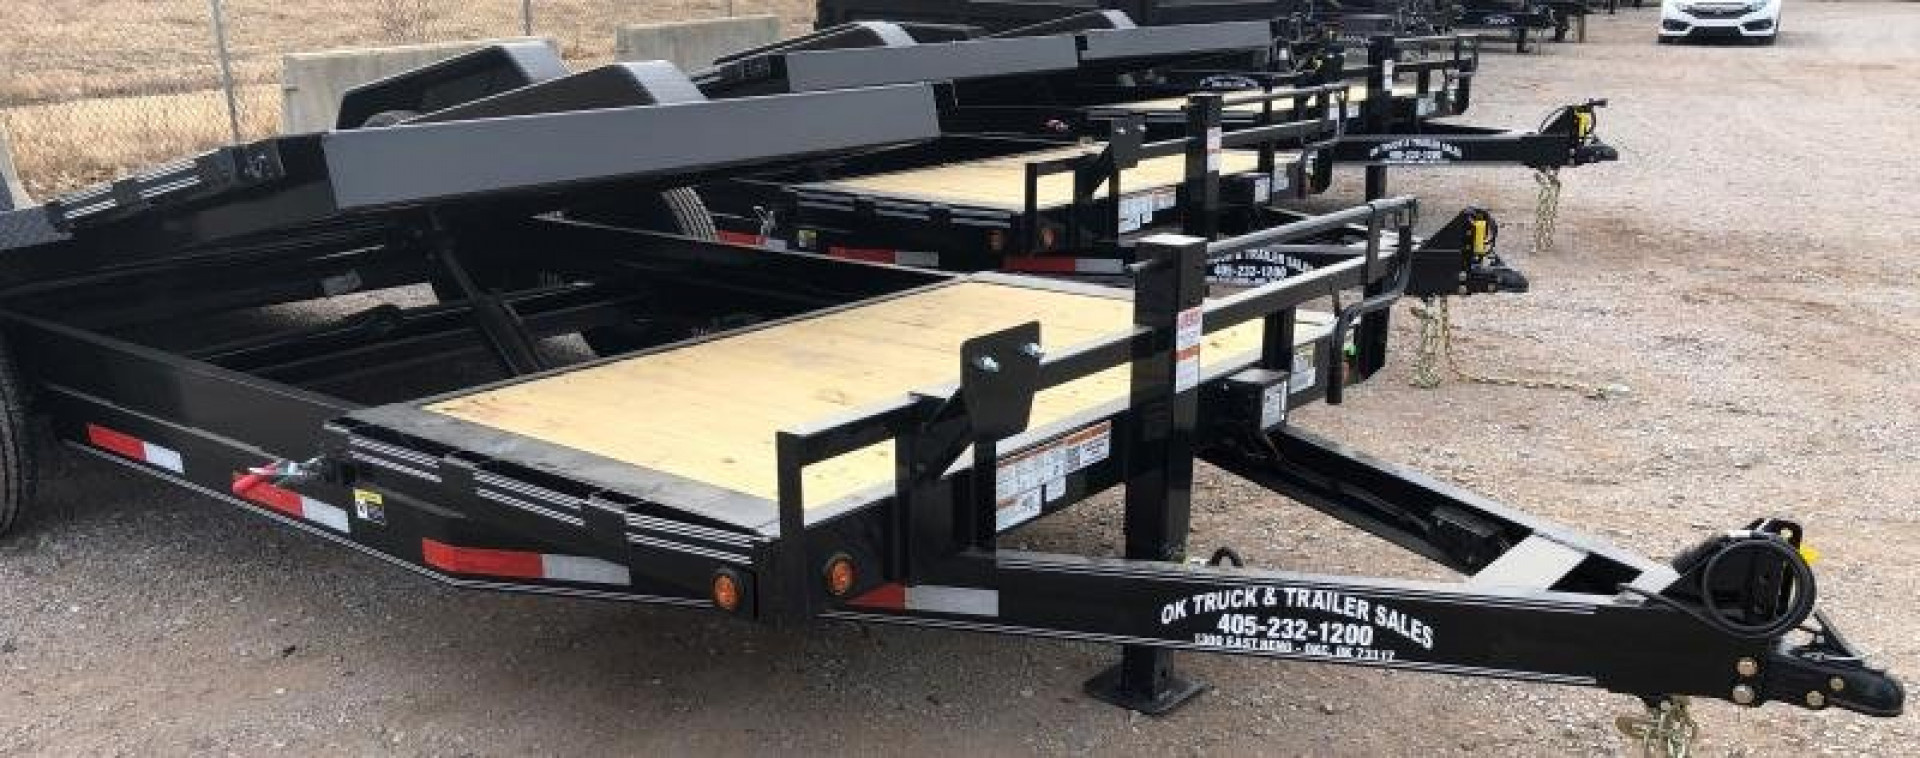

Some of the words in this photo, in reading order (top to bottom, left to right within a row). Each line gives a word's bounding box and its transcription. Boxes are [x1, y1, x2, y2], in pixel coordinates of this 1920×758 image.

[1160, 599, 1188, 625] OK
[1191, 587, 1258, 615] TRUCK
[1263, 587, 1278, 606] &
[1284, 587, 1370, 622] TRAILER
[1374, 604, 1434, 650] SALES
[1216, 613, 1374, 647] 405-232-1200
